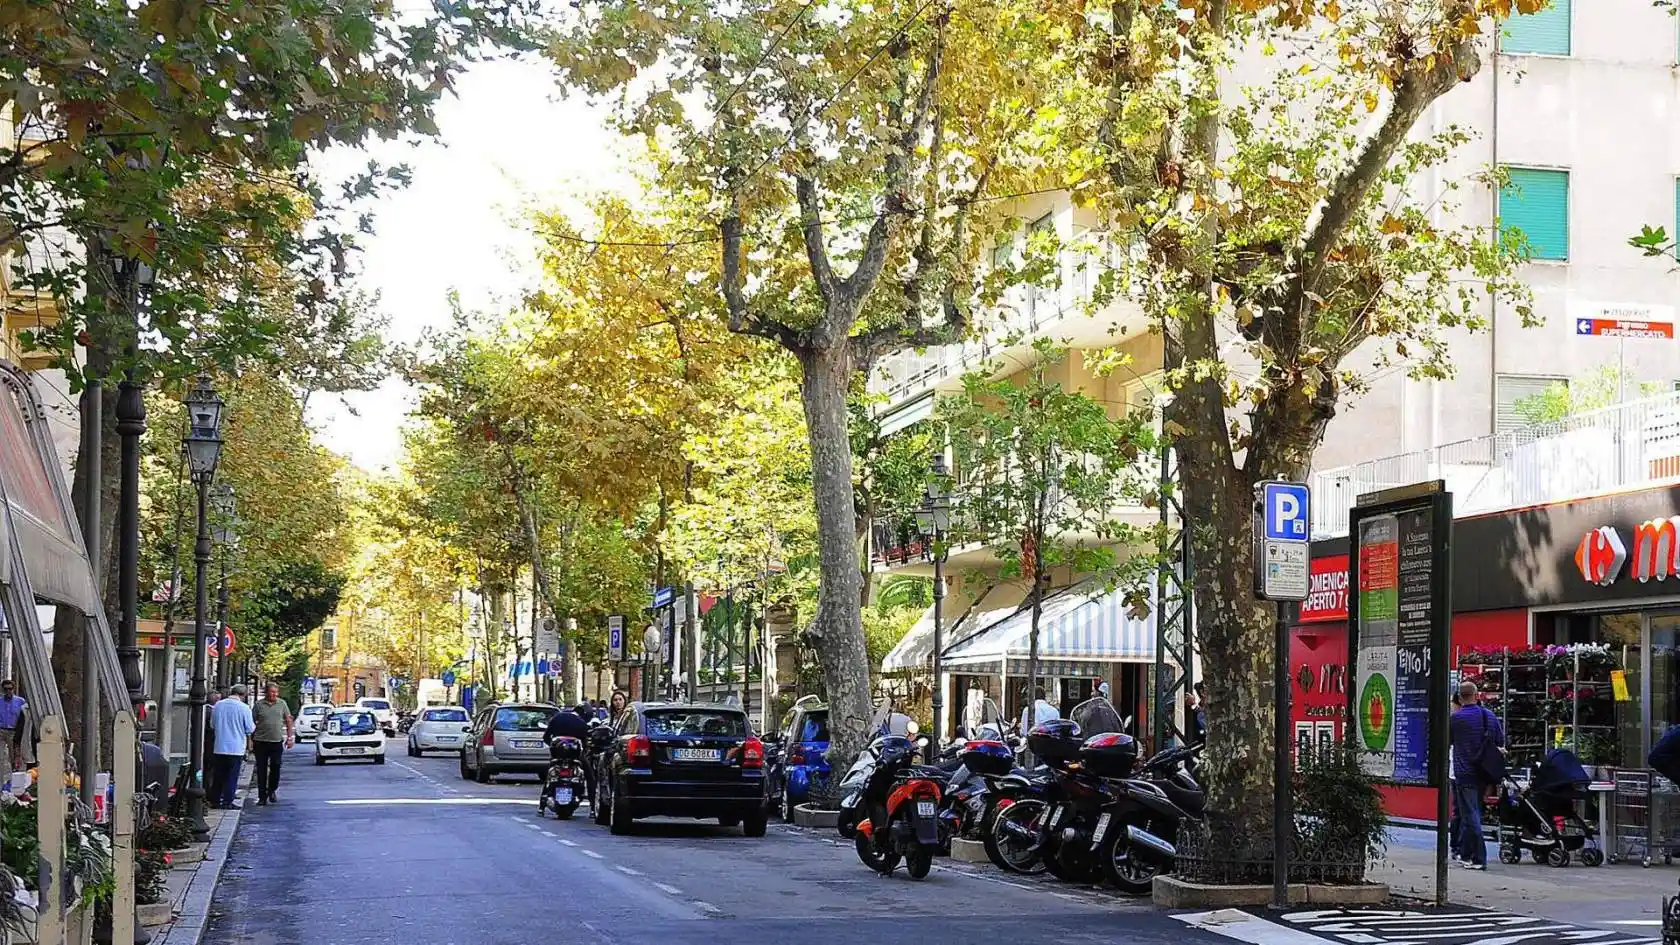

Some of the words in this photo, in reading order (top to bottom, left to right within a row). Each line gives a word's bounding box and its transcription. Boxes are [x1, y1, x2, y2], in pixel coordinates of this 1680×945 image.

[1275, 493, 1300, 533] P
[1310, 571, 1349, 593] OMENICA
[1302, 590, 1336, 612] APERTO
[1338, 590, 1344, 609] 7
